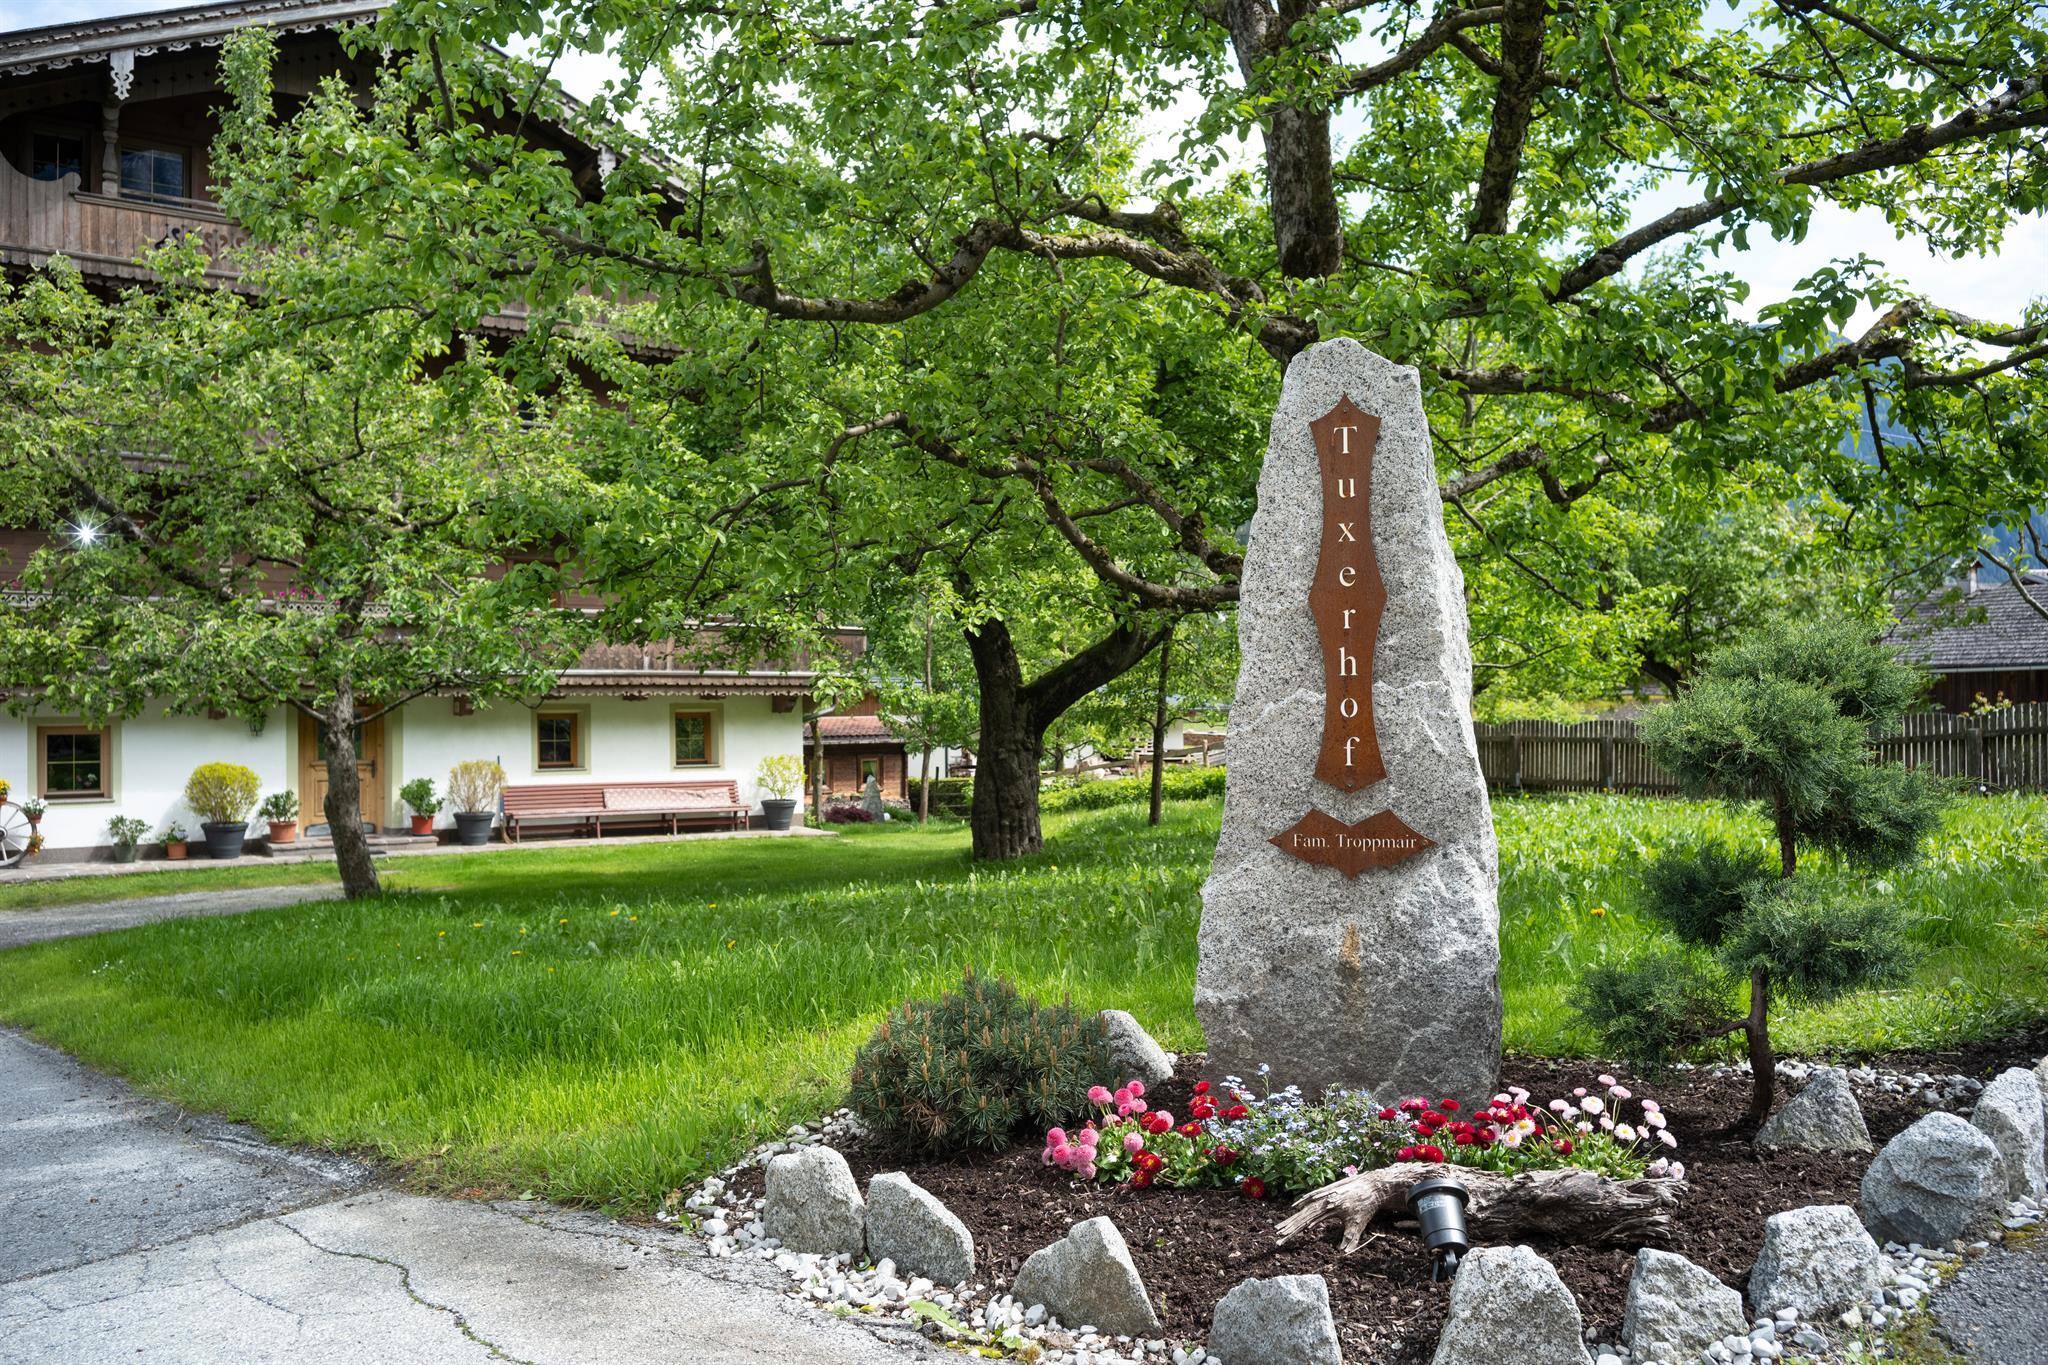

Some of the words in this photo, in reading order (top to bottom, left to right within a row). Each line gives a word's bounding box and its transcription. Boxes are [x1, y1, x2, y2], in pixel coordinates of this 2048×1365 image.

[1333, 426, 1360, 767] Tuxerhof
[1293, 833, 1330, 848] Fam.
[1335, 833, 1417, 851] Troppmair
